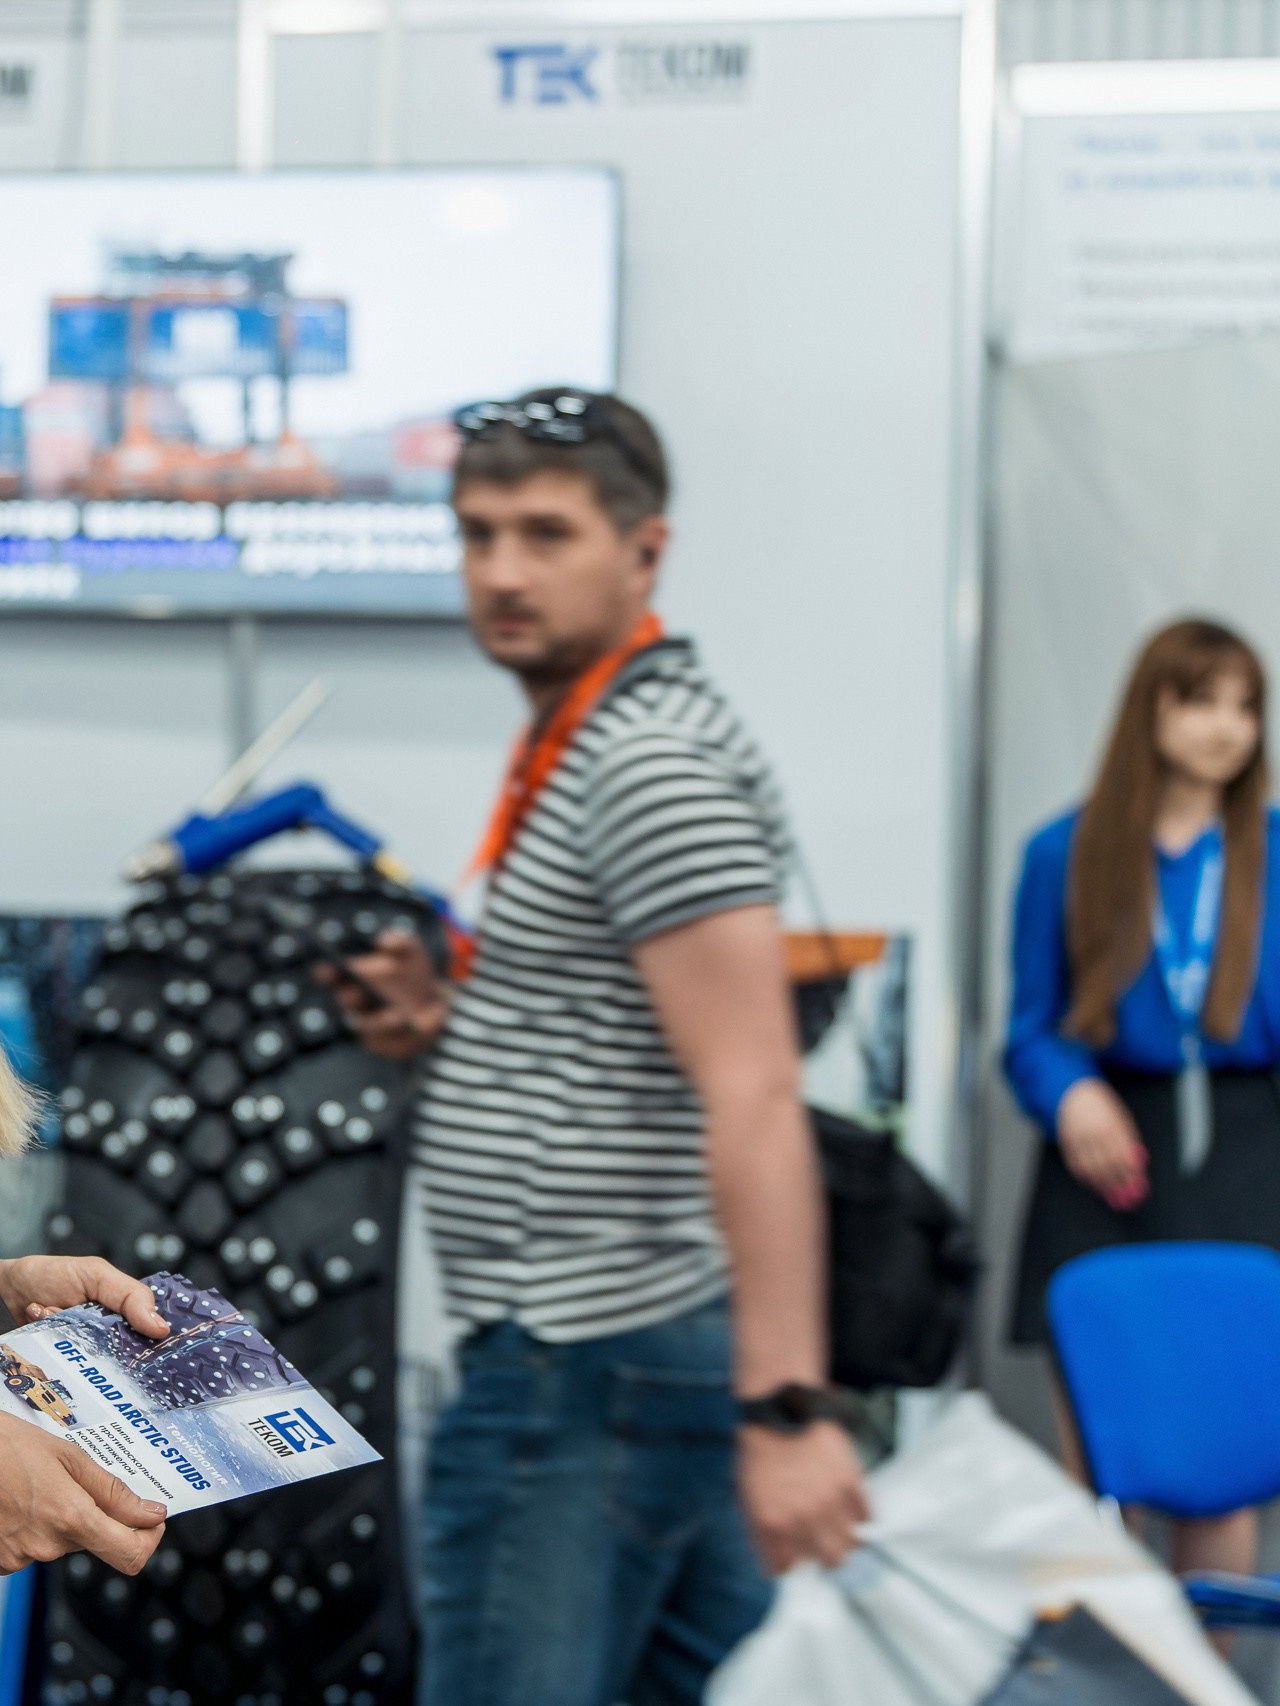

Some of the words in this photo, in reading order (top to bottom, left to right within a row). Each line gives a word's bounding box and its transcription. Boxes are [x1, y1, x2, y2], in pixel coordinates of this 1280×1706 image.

[493, 43, 599, 104] TEK
[54, 1340, 123, 1401] OFF-ROAD
[114, 1402, 169, 1448] ARCTIC
[160, 1447, 211, 1491] STUDS
[110, 1421, 135, 1445] Шипы
[269, 1408, 333, 1453] TEK
[76, 1430, 114, 1467] колесной
[86, 1428, 104, 1443] для
[103, 1442, 137, 1476] тяжелой
[98, 1425, 174, 1500] противоскольжения
[166, 1422, 228, 1484] Технология
